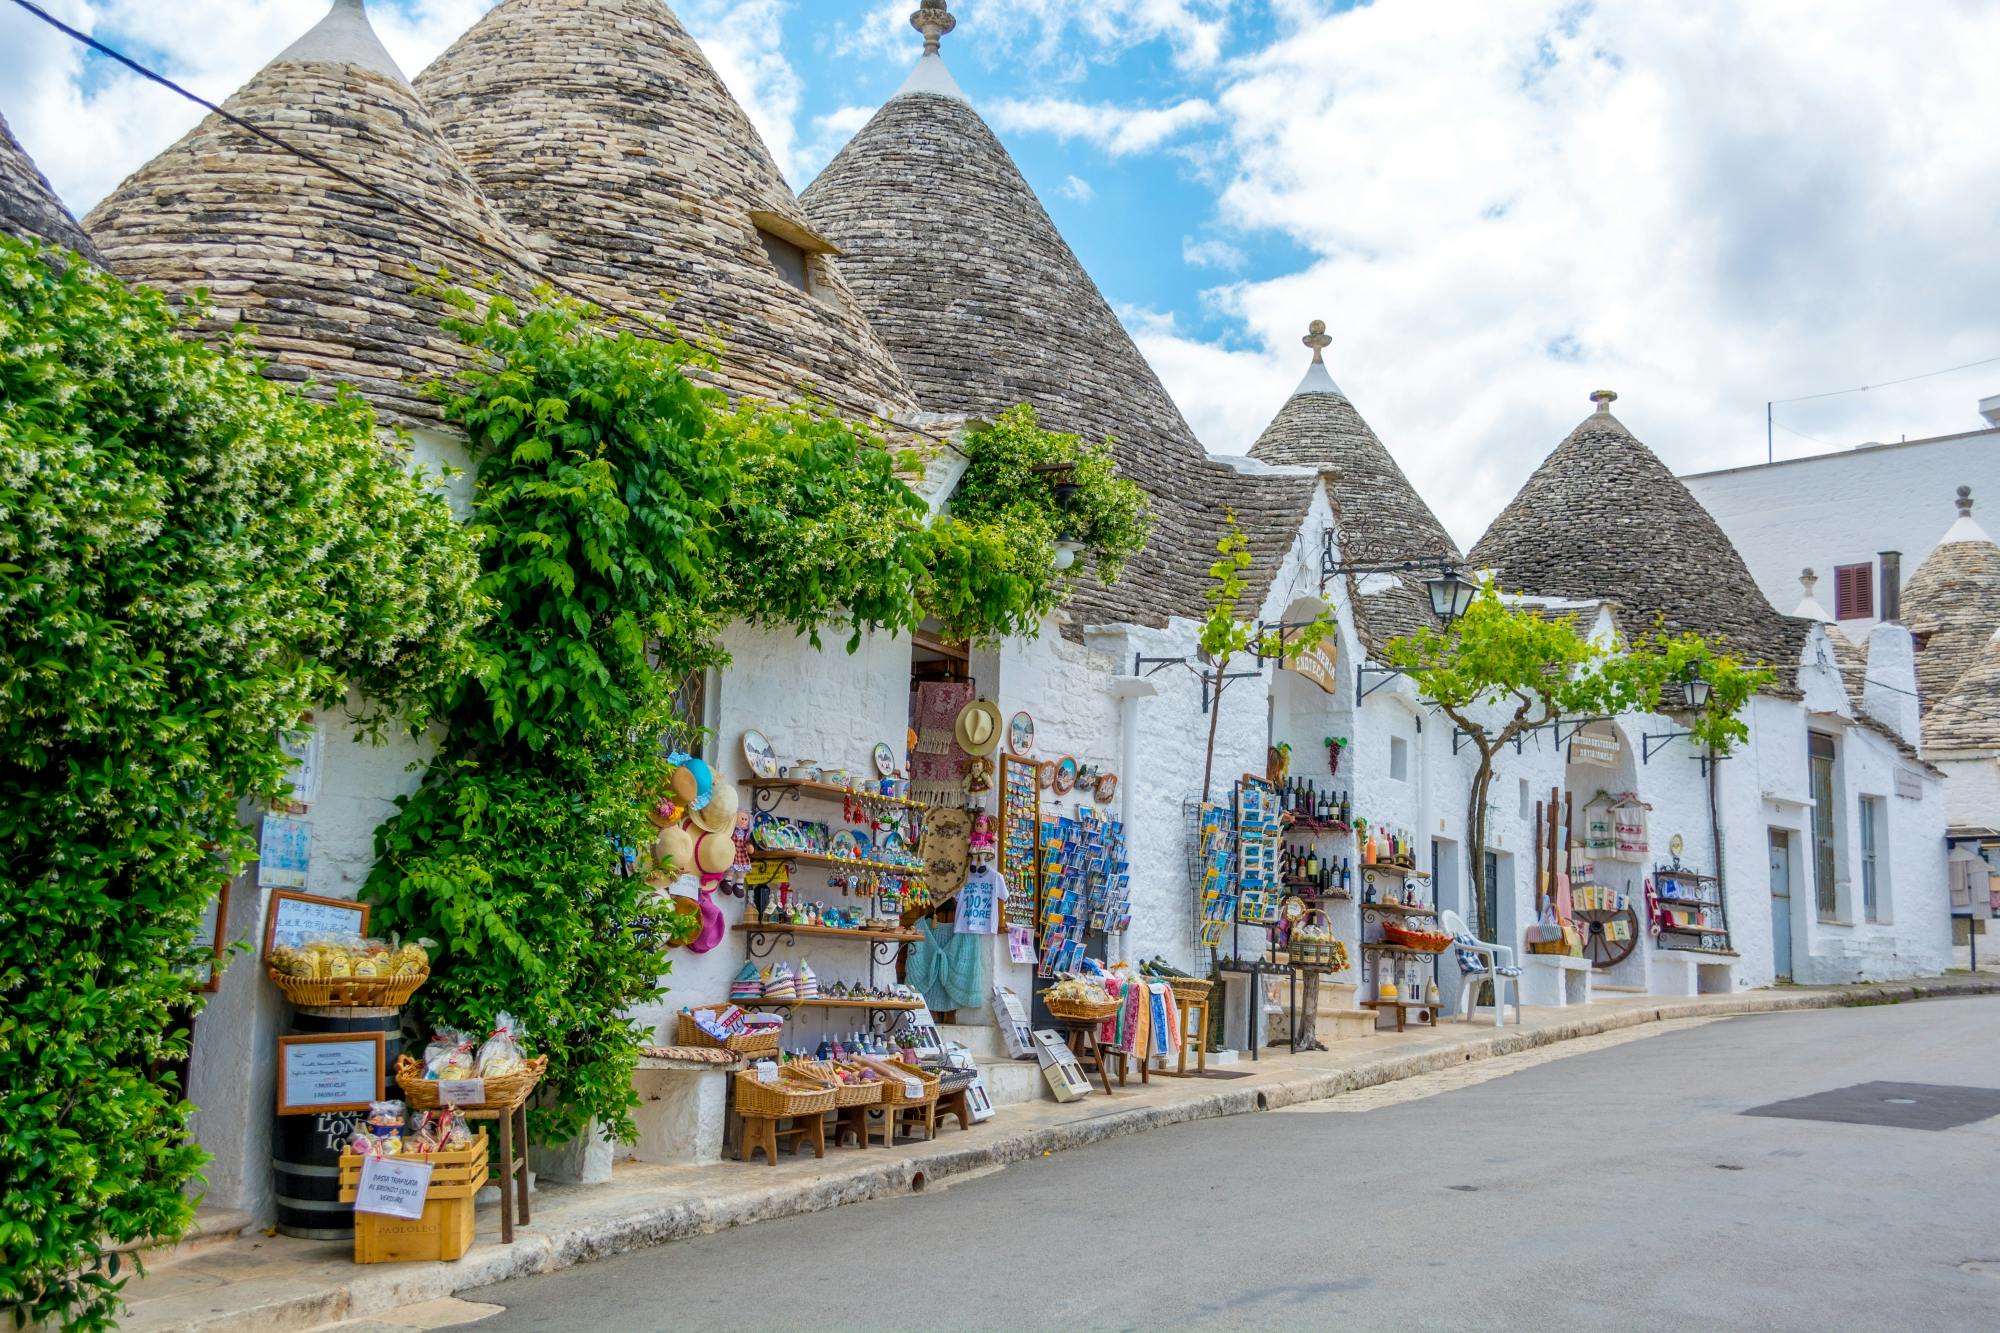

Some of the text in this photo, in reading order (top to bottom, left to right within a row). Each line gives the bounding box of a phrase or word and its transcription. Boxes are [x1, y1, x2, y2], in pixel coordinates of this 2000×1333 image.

[1295, 655, 1325, 683] ENOTECA
[981, 882, 993, 890] 50%
[963, 895, 992, 909] 100%
[963, 909, 991, 918] AMORE
[317, 1117, 358, 1135] LON
[373, 1174, 418, 1186] PASTA TRAFILATA
[376, 1184, 399, 1193] BRONZO
